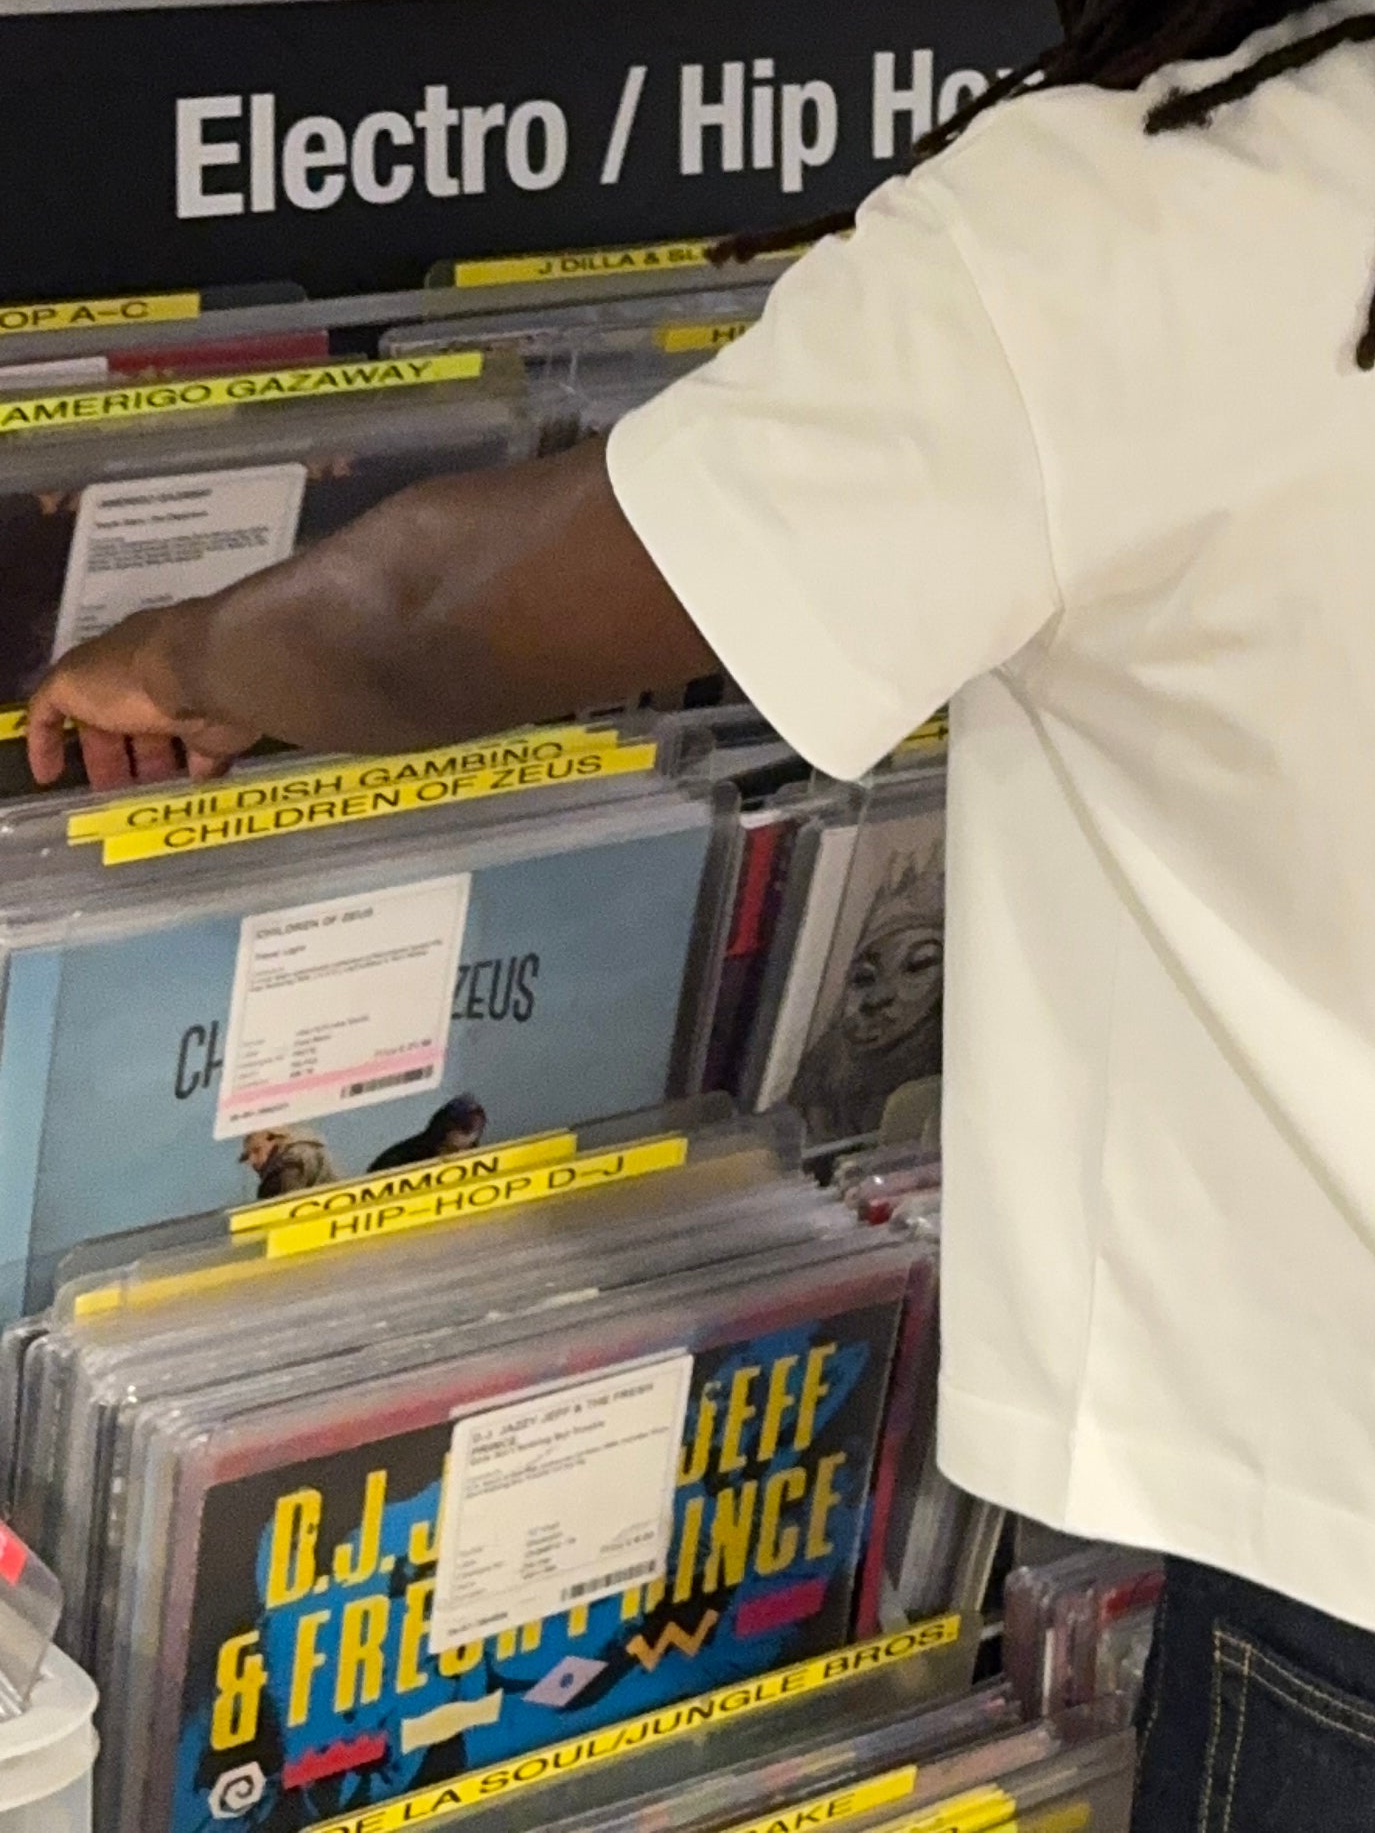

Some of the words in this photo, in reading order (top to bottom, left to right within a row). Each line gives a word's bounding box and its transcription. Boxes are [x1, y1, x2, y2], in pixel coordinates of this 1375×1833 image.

[174, 84, 568, 219] Electro
[600, 66, 648, 184] /
[679, 55, 839, 192] Hip
[561, 253, 635, 273] DILLA
[0, 383, 214, 427] AMERIGO
[226, 359, 437, 400] GAZAWAY
[126, 773, 345, 829] CHILDISH
[358, 740, 564, 790] GAMBINO
[163, 787, 402, 850] CHILDREN
[415, 772, 477, 802] OF
[489, 754, 604, 789] ZEUS
[330, 1176, 531, 1239] HIP-HOP
[548, 1155, 625, 1190] D-J
[266, 1469, 397, 1610] D.J.
[210, 1629, 269, 1751] &
[286, 1578, 542, 1729] FRE
[568, 1451, 848, 1638] INCE
[404, 1788, 462, 1821] LA
[478, 1672, 808, 1795] SOUL/JUNGLE
[823, 1622, 956, 1680] BROS.
